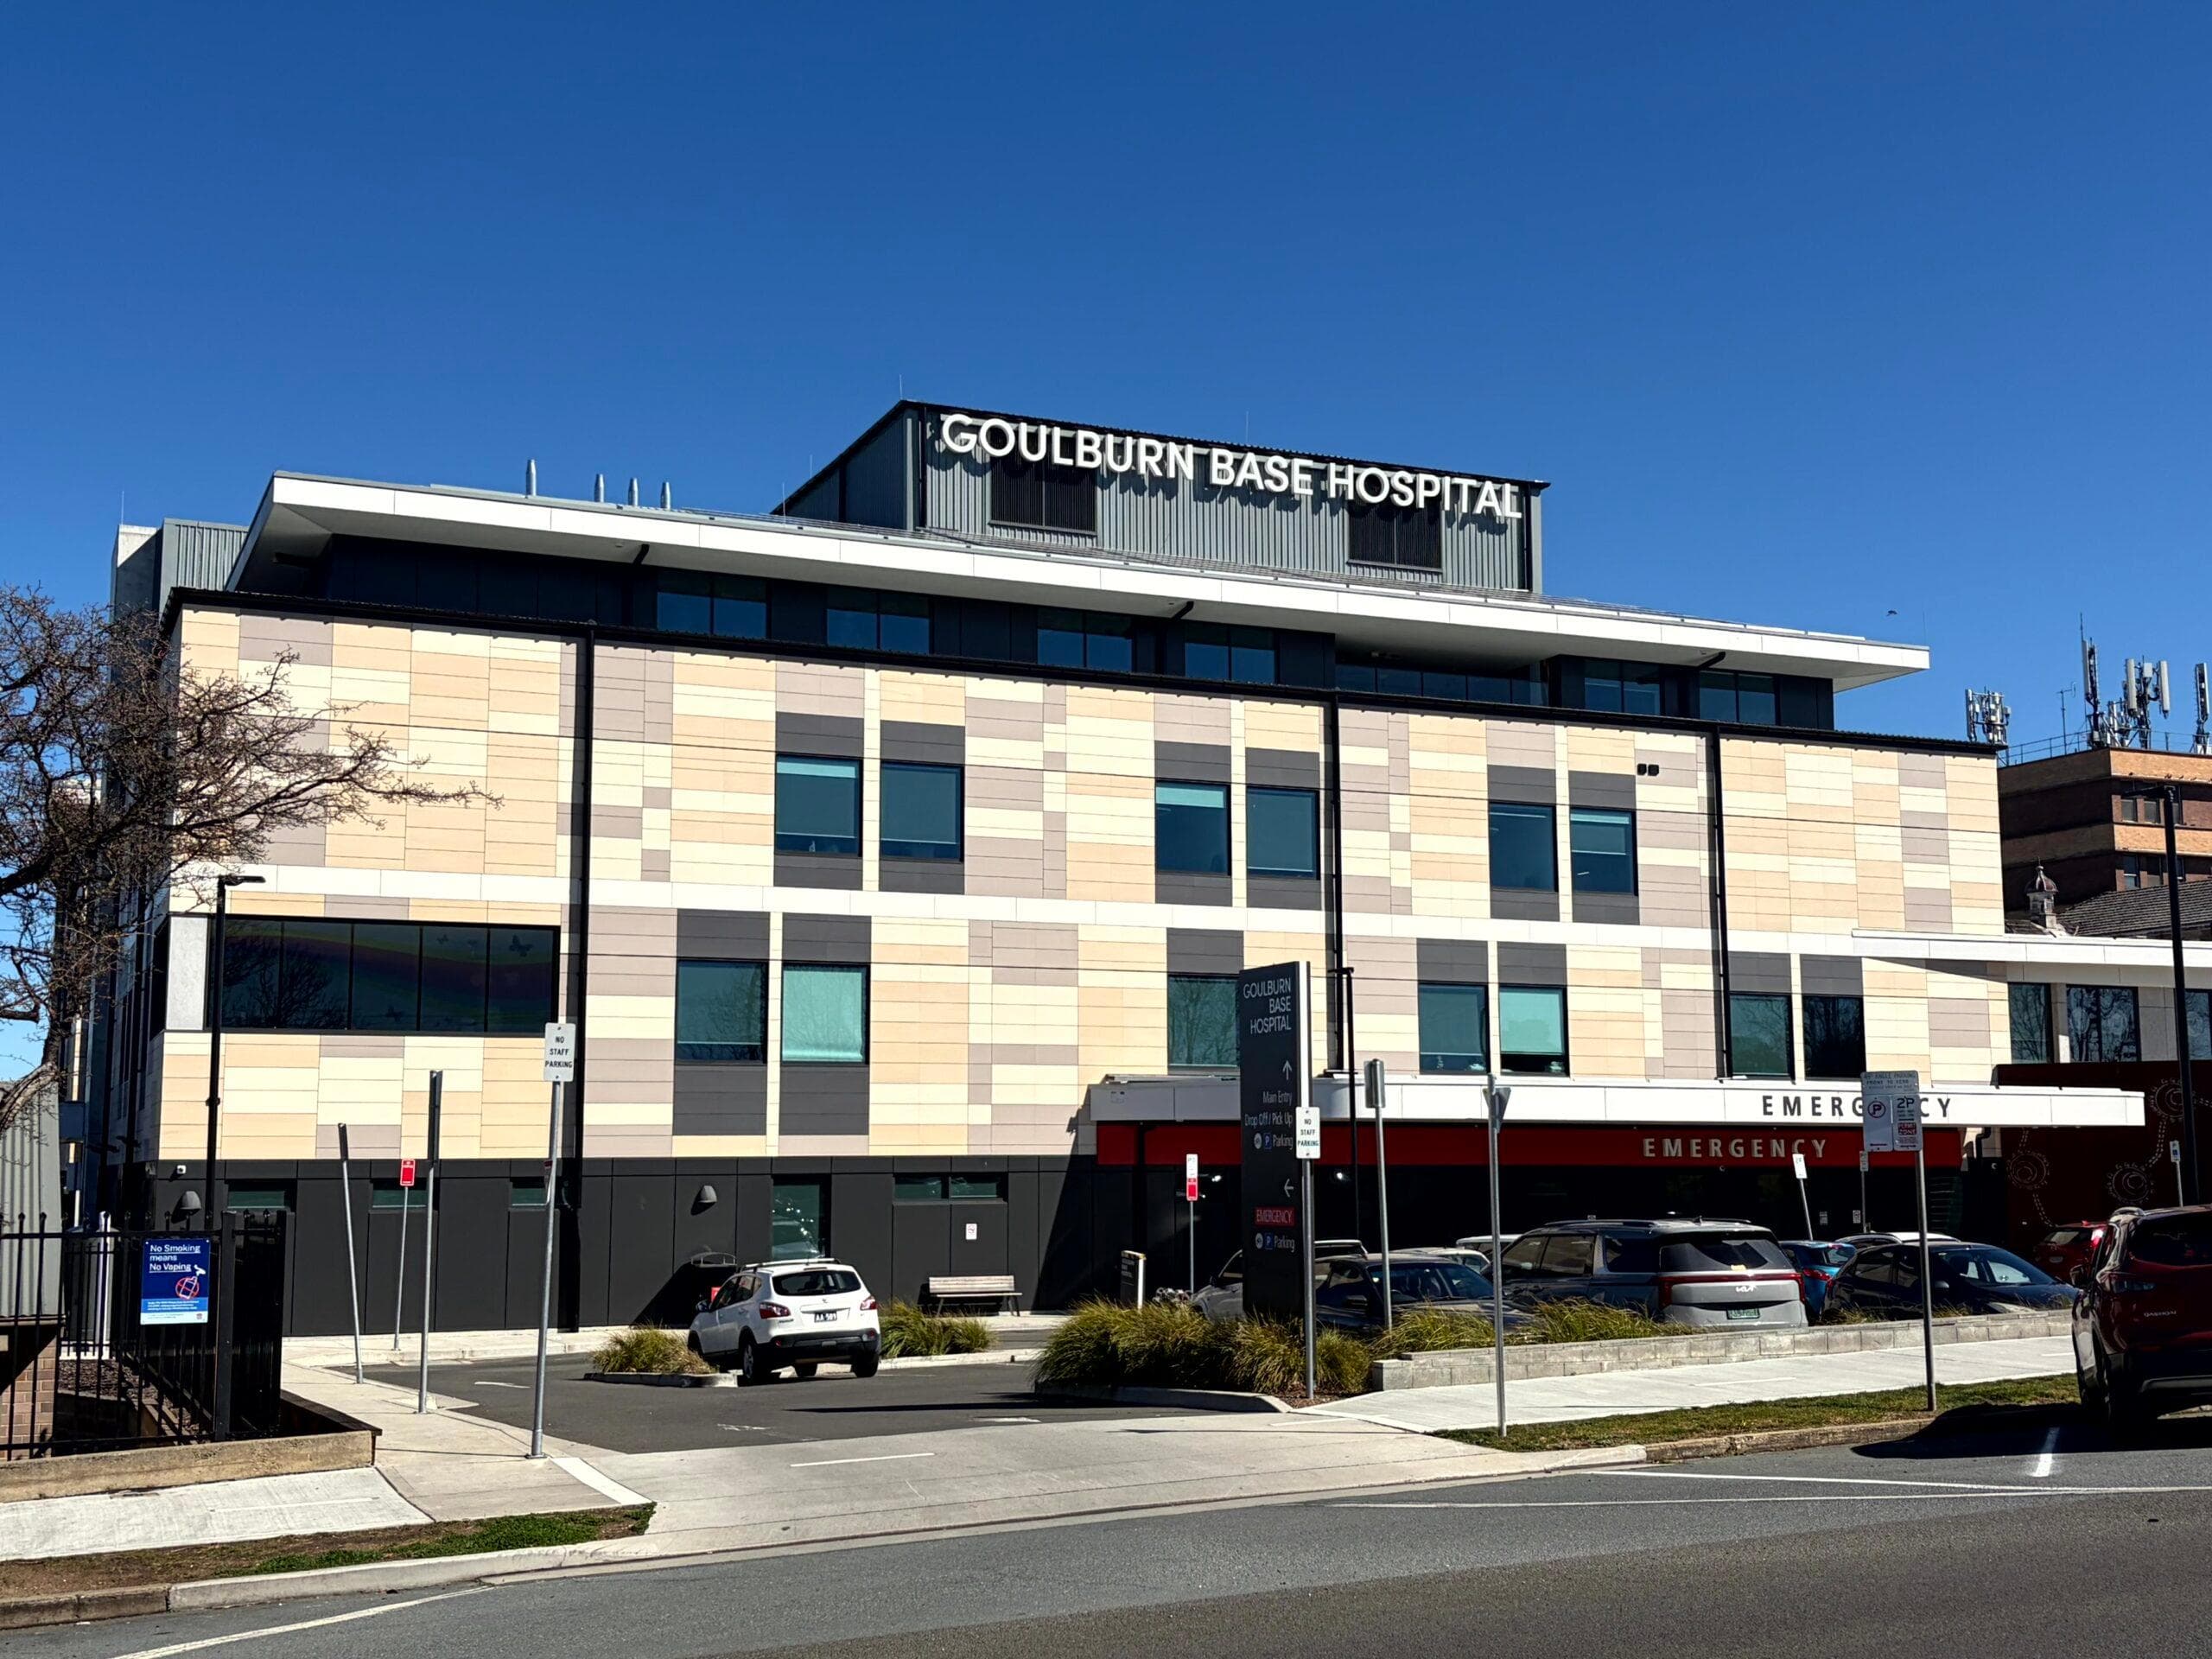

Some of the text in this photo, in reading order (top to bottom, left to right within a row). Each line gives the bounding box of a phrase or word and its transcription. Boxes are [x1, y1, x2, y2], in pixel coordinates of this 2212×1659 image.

[942, 413, 1522, 518] GOULBURN BASE HOSPITAL
[1243, 977, 1292, 999] GOULBURN
[1269, 996, 1292, 1014] BASE
[1250, 1015, 1292, 1034] HOSPITAL
[1262, 1090, 1293, 1106] Main Entry
[1763, 1095, 1951, 1117] EMERGCY
[1897, 1097, 1915, 1109] 2P
[1244, 1113, 1258, 1128] Drop
[1259, 1111, 1268, 1126] Off
[1272, 1111, 1283, 1126] Pick
[1284, 1111, 1294, 1128] Up
[1273, 1134, 1294, 1150] Parking
[1643, 1138, 1827, 1158] EMERGENCY
[1256, 1209, 1294, 1224] EMERGENCY
[164, 1244, 200, 1253] Smoking
[1274, 1235, 1295, 1253] Parking
[163, 1262, 192, 1272] Vaping
